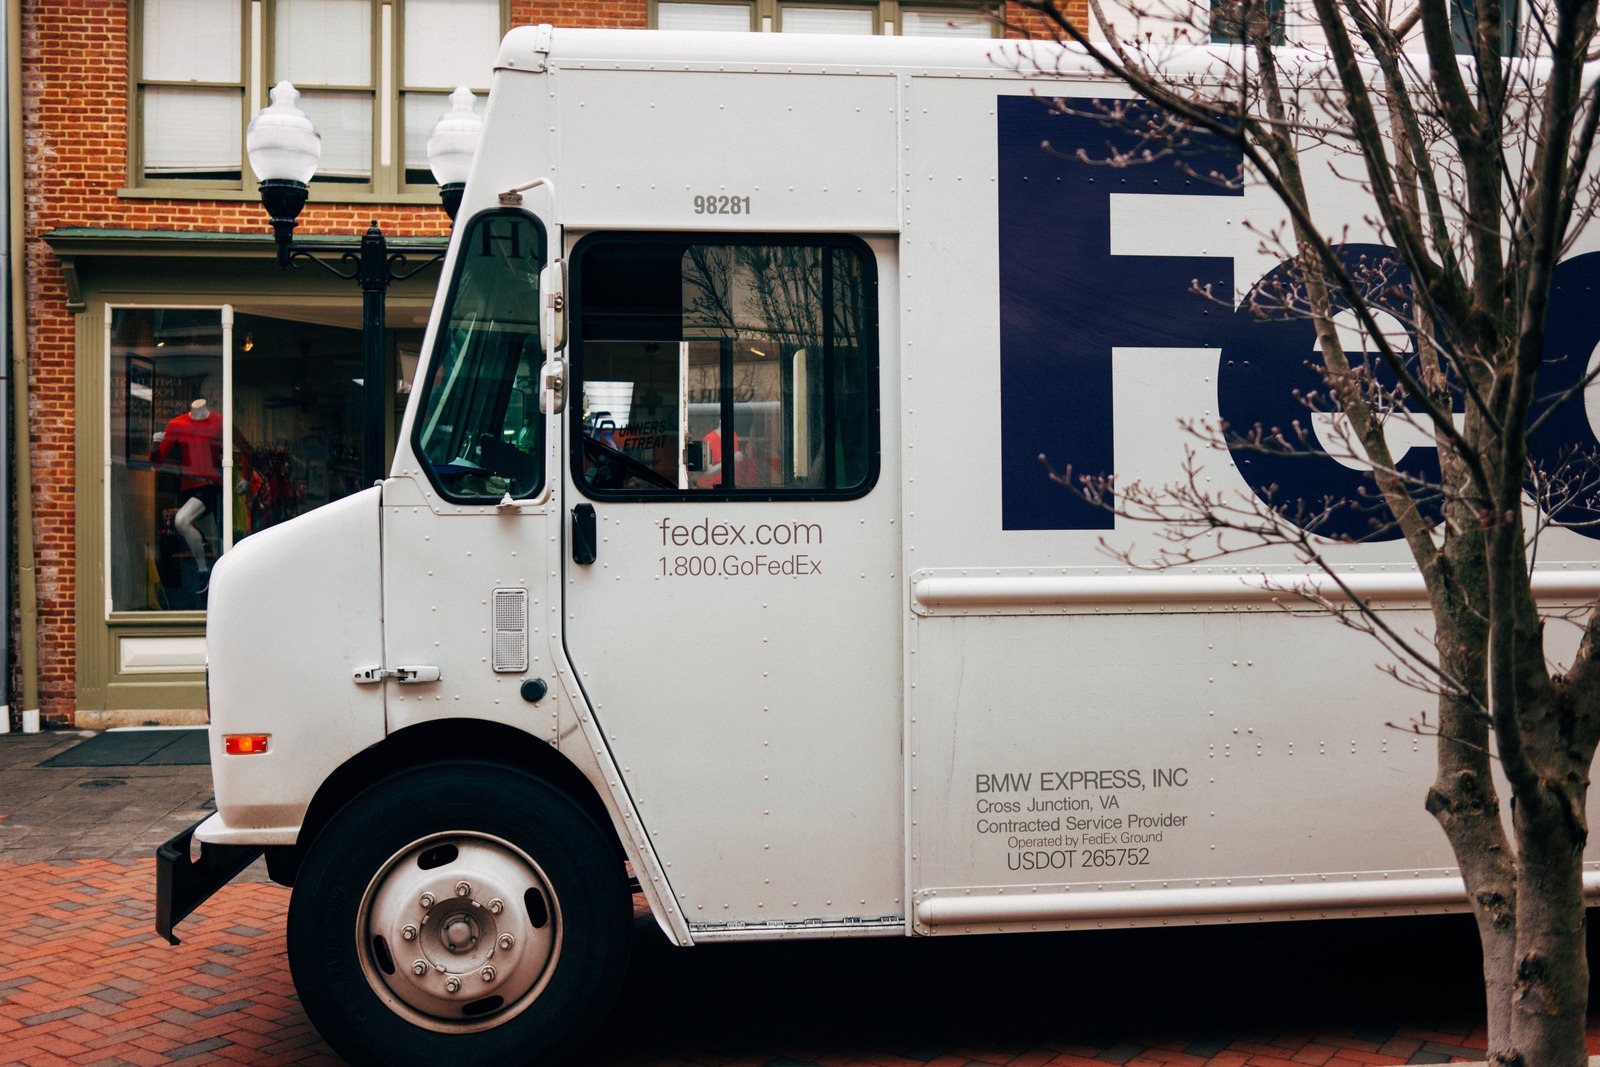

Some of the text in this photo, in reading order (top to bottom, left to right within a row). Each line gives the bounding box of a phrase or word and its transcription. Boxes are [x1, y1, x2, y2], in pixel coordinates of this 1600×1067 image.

[693, 195, 750, 214] 98281
[658, 517, 823, 546] fedex.com
[658, 555, 823, 577] 1.800.GoFedEx
[976, 768, 1189, 793] BMW EXPRESS, INC
[976, 795, 1120, 813] Cross Junction, VA
[976, 813, 1188, 833] Contracted Service Provider
[1008, 831, 1163, 850] Operated by FedEx Ground
[1007, 848, 1150, 870] USDOT 265752
